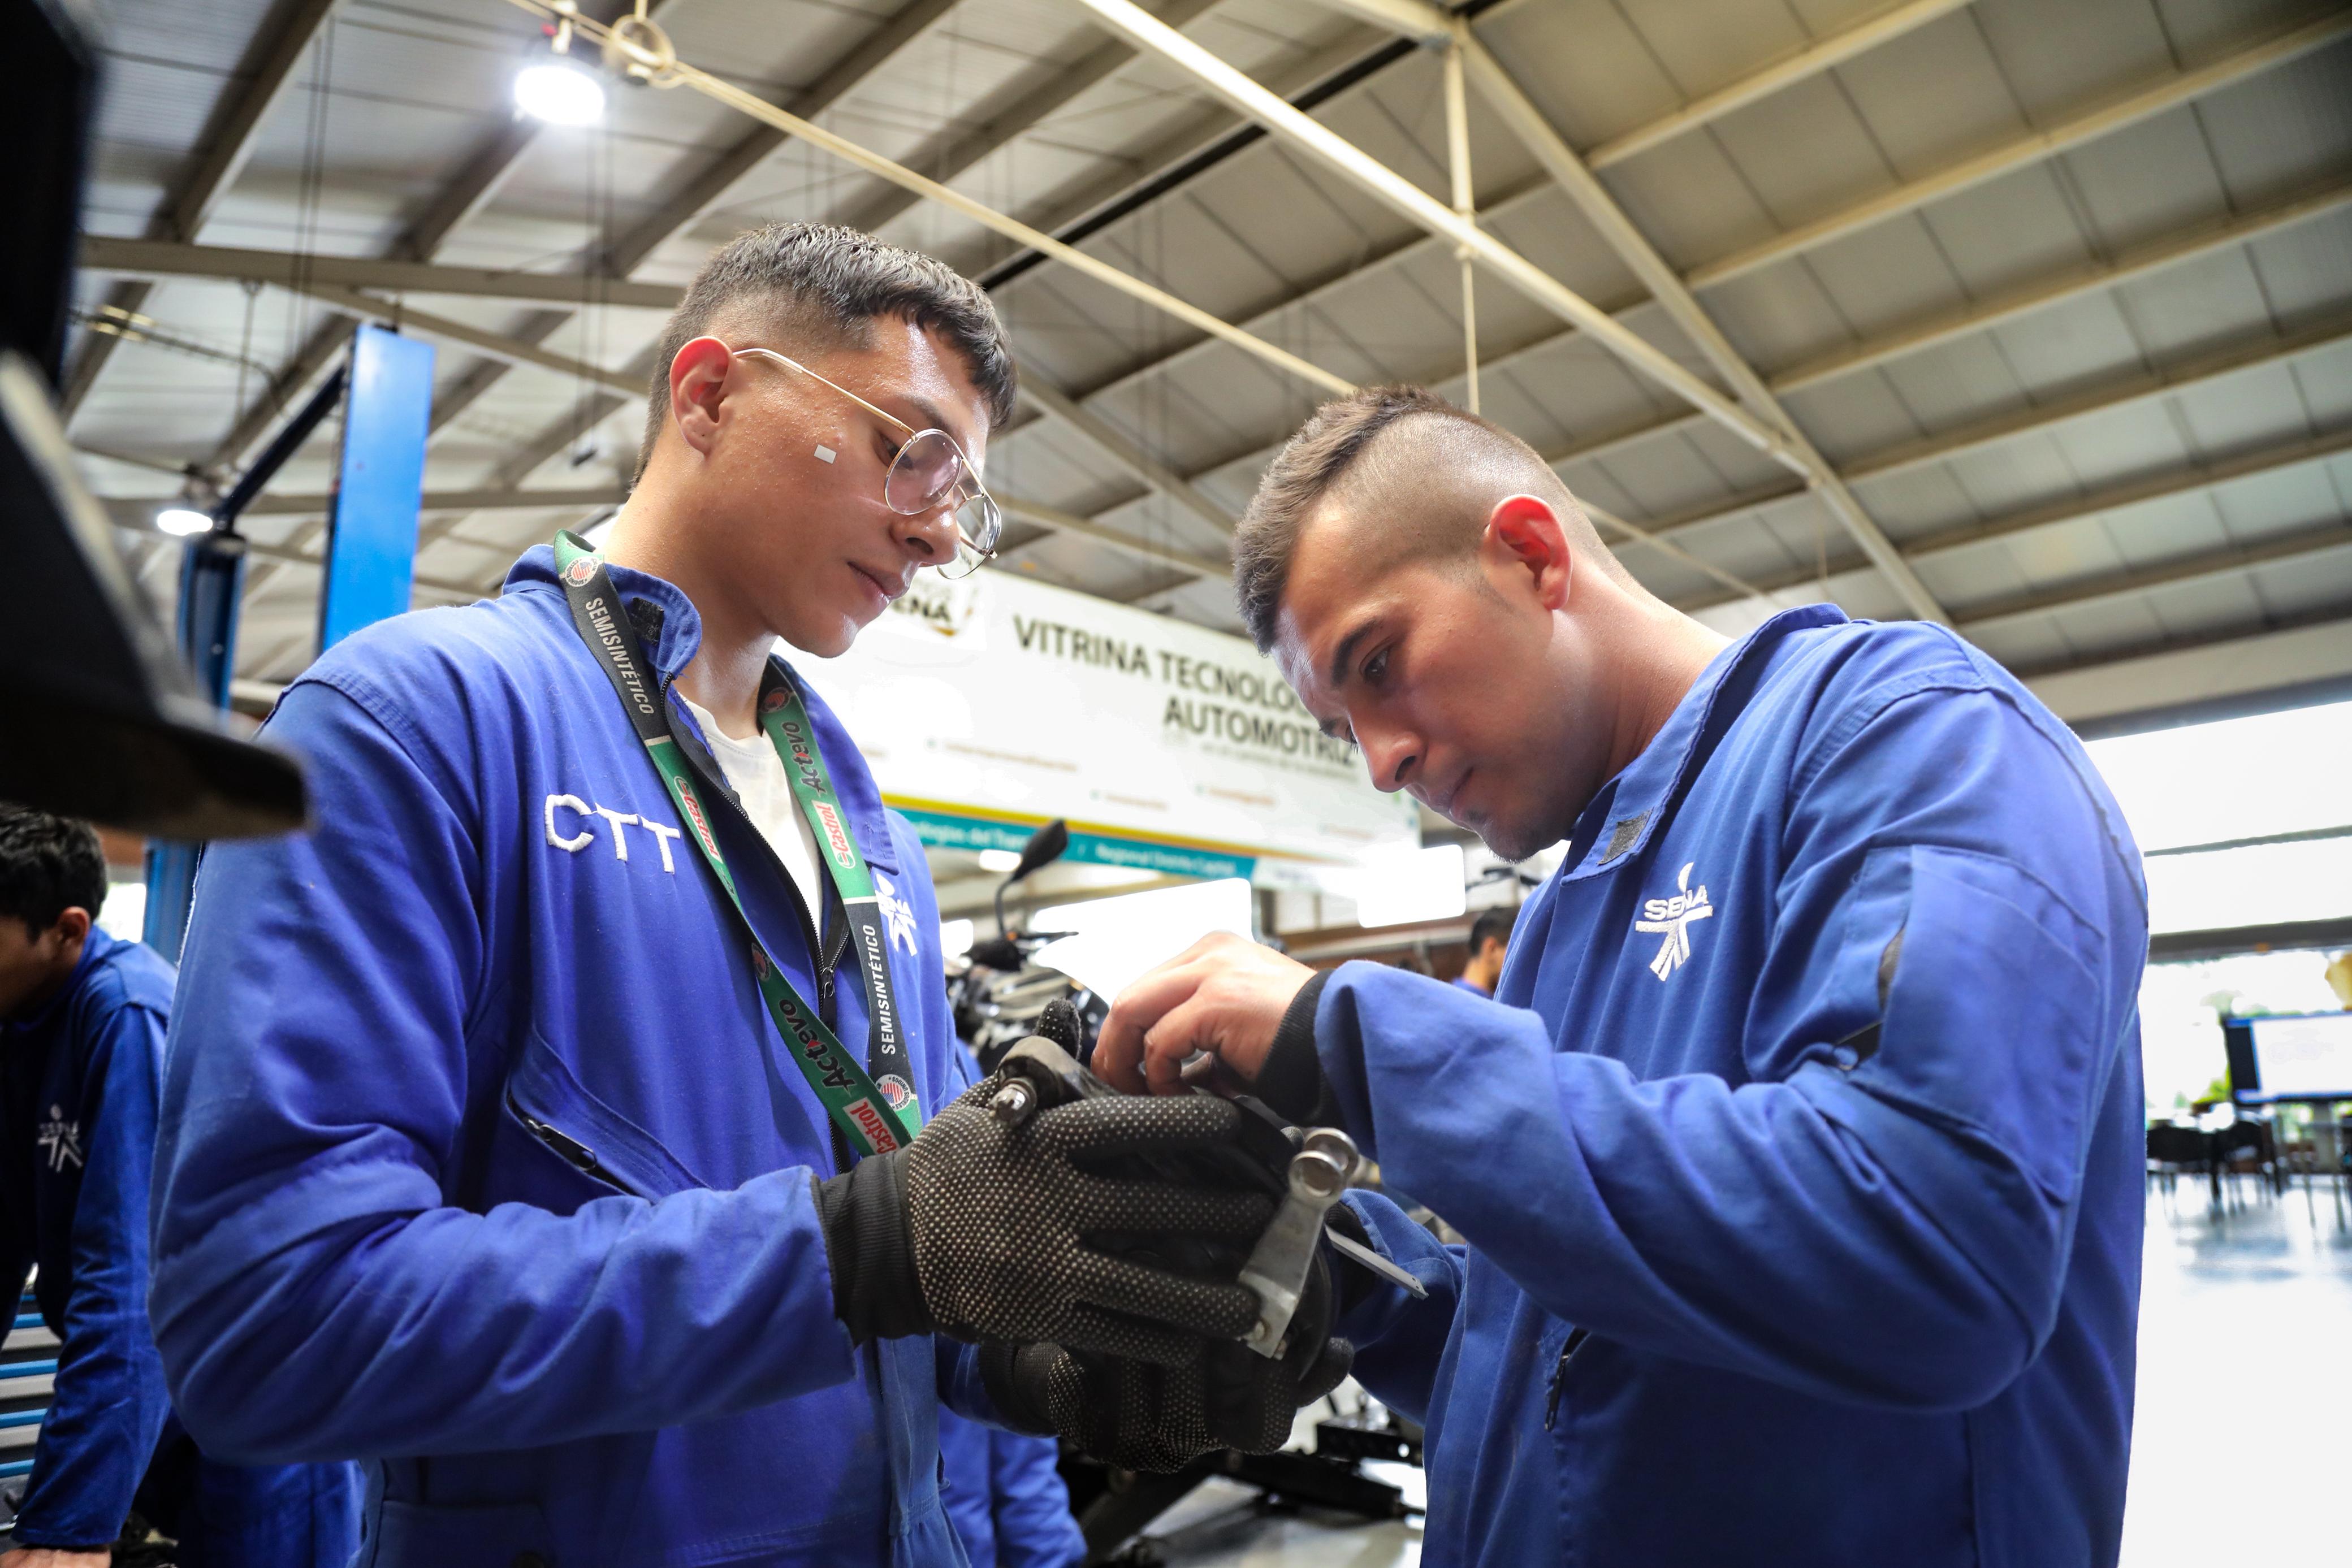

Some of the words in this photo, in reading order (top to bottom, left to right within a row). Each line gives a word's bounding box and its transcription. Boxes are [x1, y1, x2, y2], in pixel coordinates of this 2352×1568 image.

[890, 595, 952, 625] ENA
[585, 597, 655, 714] SEMISINTÉTICO
[1013, 613, 1152, 679] VITRINA
[1157, 649, 1311, 717] TECNOLO
[782, 721, 827, 795] Actevo
[1163, 696, 1356, 768] AUTOMOTRIZ
[544, 794, 681, 874] CTT
[684, 795, 719, 856] Castrol
[816, 804, 849, 852] Castrol
[863, 925, 896, 1055] SEMISINTÉTICO
[779, 999, 857, 1095] Actevo
[850, 1101, 897, 1155] Castrol
